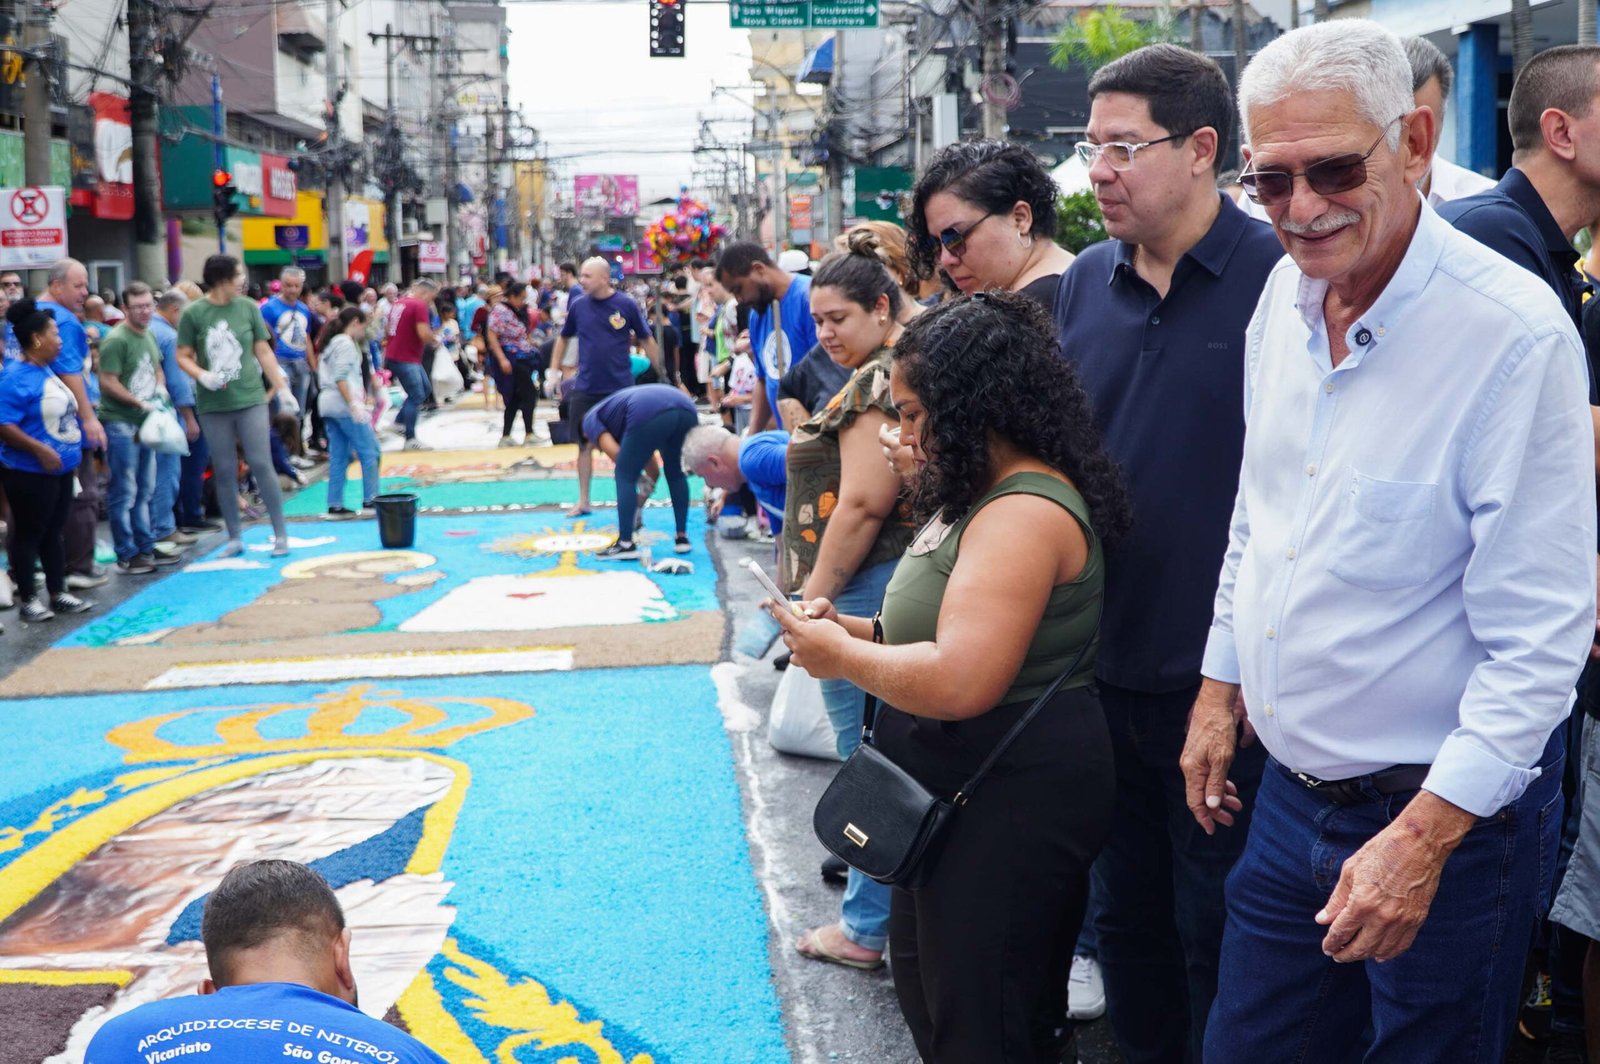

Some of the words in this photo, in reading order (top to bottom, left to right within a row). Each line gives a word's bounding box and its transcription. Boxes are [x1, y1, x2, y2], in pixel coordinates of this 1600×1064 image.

[765, 6, 798, 16] Miguel
[742, 17, 767, 25] Nova
[138, 1018, 284, 1053] ARQUIDIOCESE
[287, 1021, 315, 1036] DE
[144, 1041, 212, 1064] Vicariato
[283, 1042, 313, 1059] São
